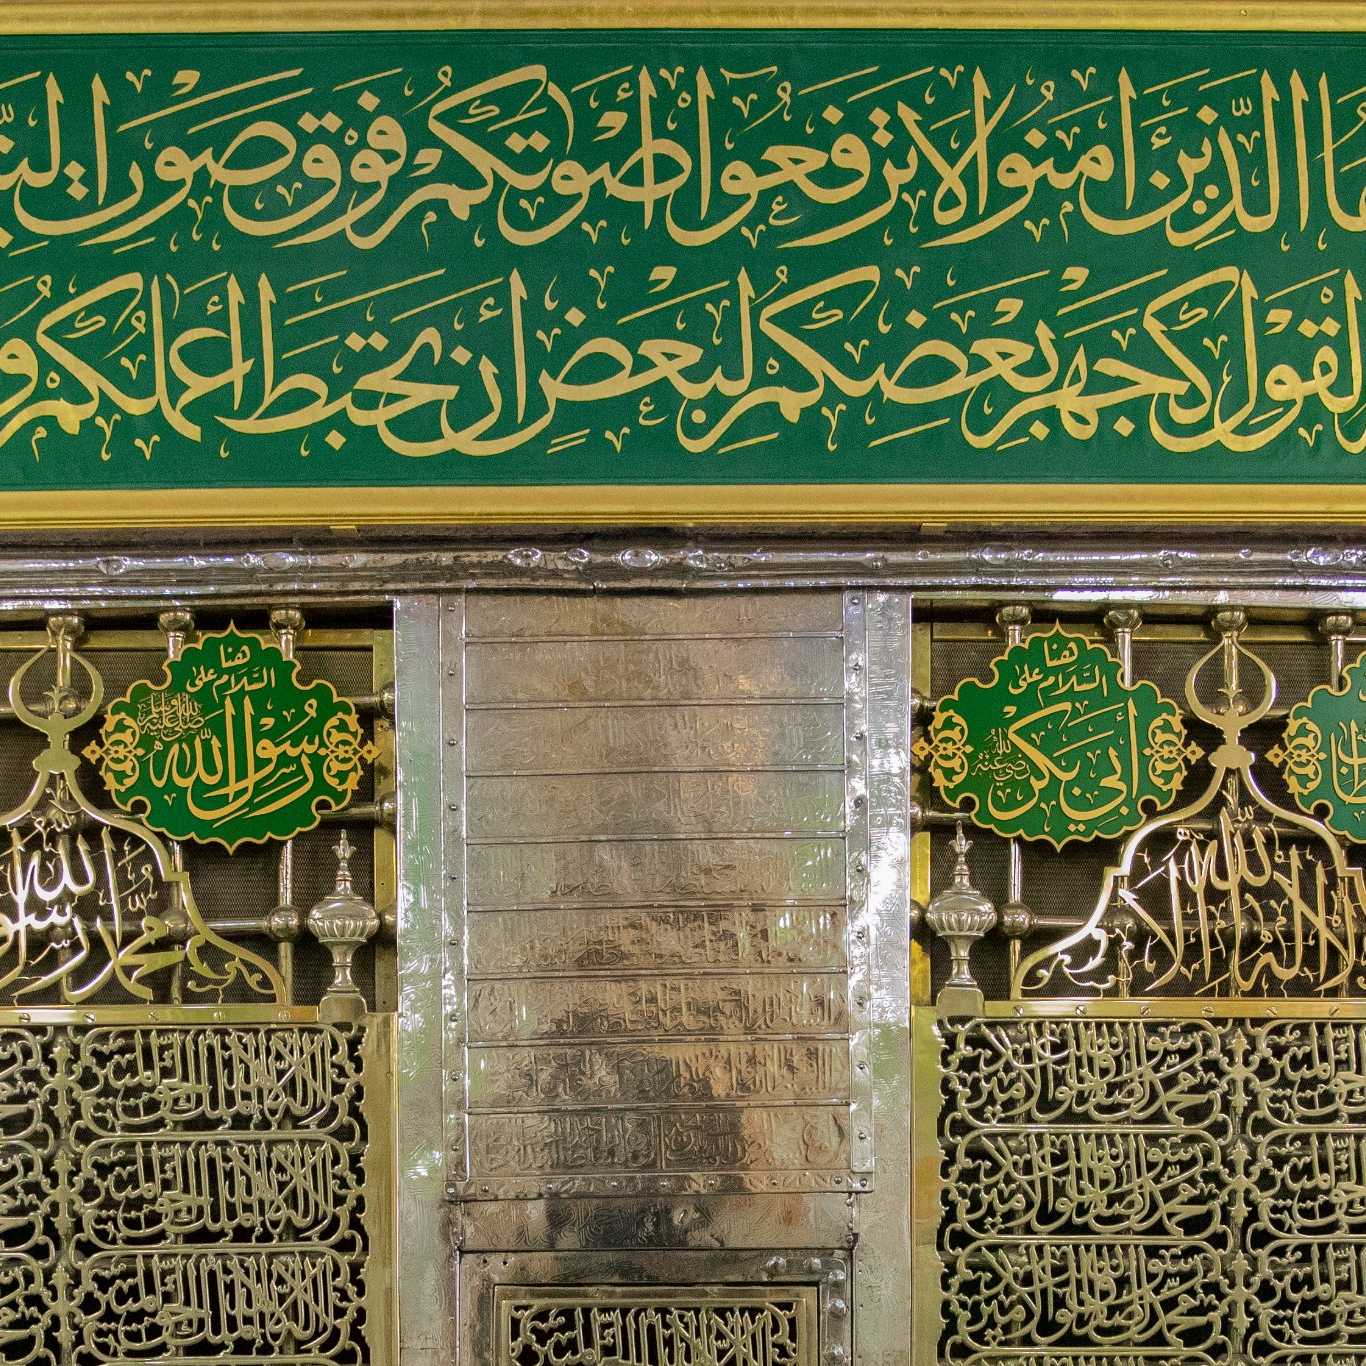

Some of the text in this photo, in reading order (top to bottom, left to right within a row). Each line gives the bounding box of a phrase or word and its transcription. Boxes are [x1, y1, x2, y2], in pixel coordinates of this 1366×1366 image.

[223, 90, 407, 249] فوق
[666, 65, 921, 249] ترفعوا
[897, 83, 1016, 227] لا
[213, 271, 458, 451] تحبط
[441, 266, 756, 458] لبعض
[677, 265, 1060, 454] بعضكم
[961, 265, 1242, 451] كجهر
[186, 665, 276, 704] السلام على
[218, 643, 251, 669] هنا
[1008, 663, 1108, 708] السلام على
[1043, 640, 1079, 668] هنا
[147, 694, 319, 828] رسول الله
[987, 700, 1081, 821] بكر
